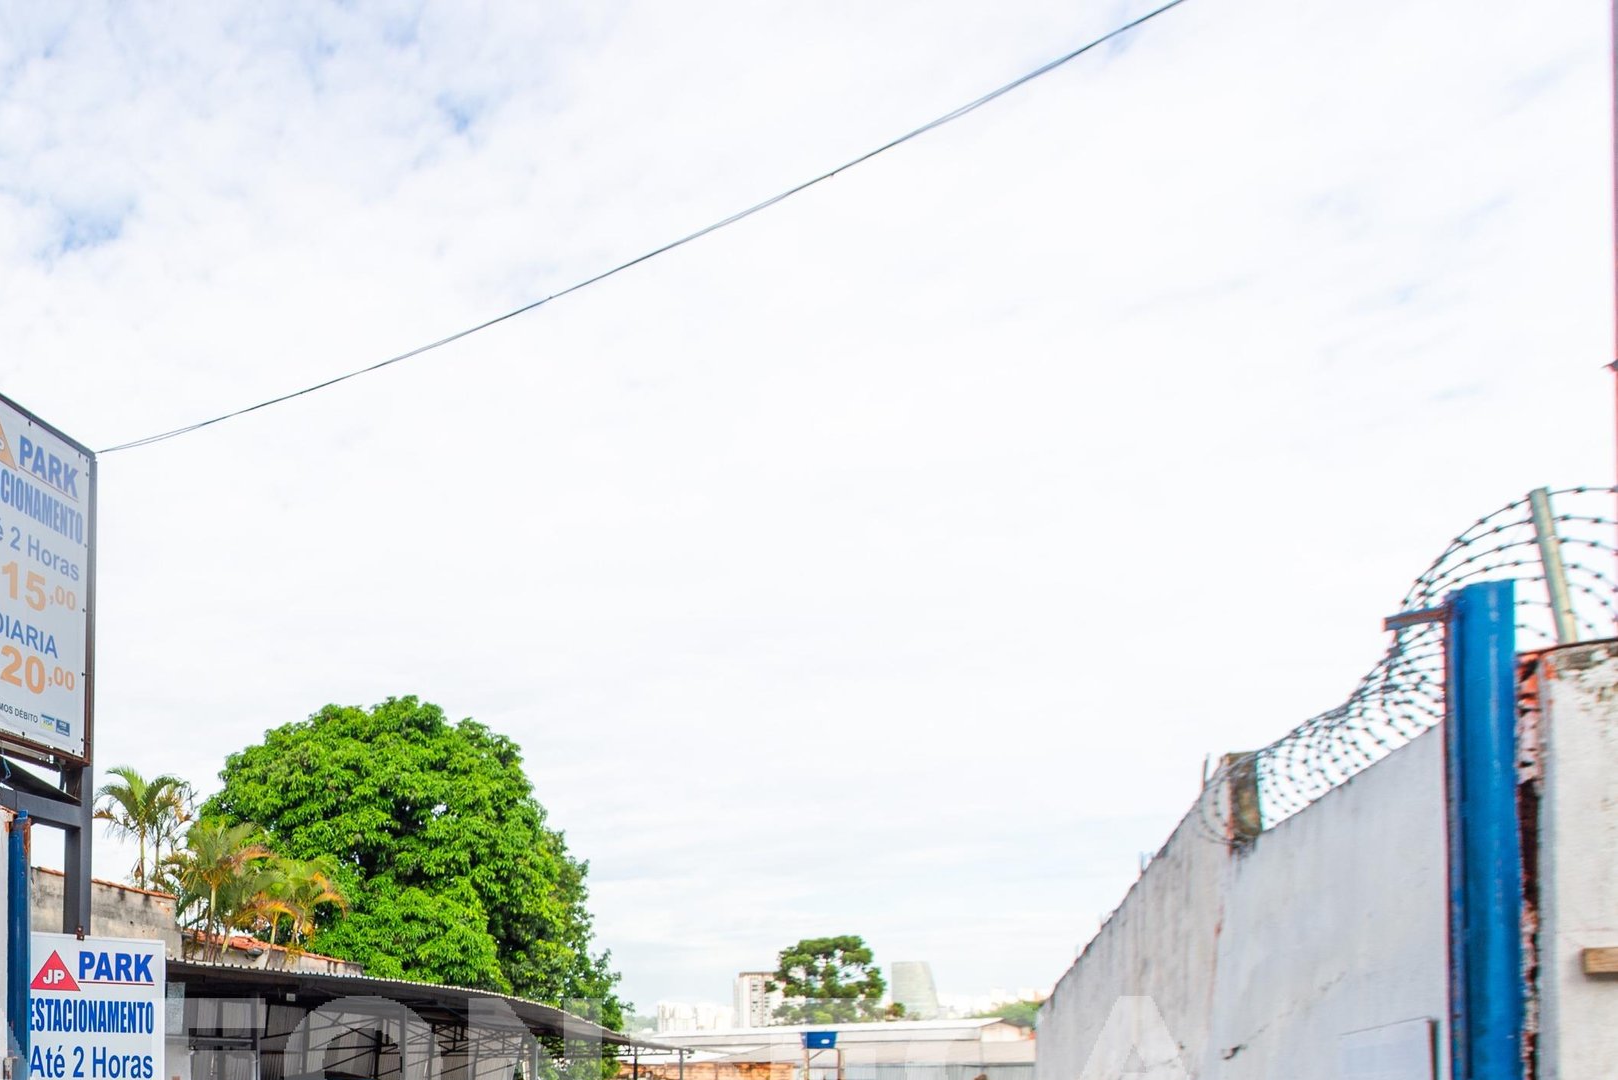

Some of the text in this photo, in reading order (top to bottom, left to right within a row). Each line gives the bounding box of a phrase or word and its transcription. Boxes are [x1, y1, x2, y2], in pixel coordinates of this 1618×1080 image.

[19, 434, 79, 499] PARK
[10, 526, 21, 552] 2
[28, 533, 79, 581] Horas
[15, 707, 38, 723] DÉBITO
[42, 951, 153, 985] JP PARK
[30, 1045, 153, 1078] Até 2 Horas
